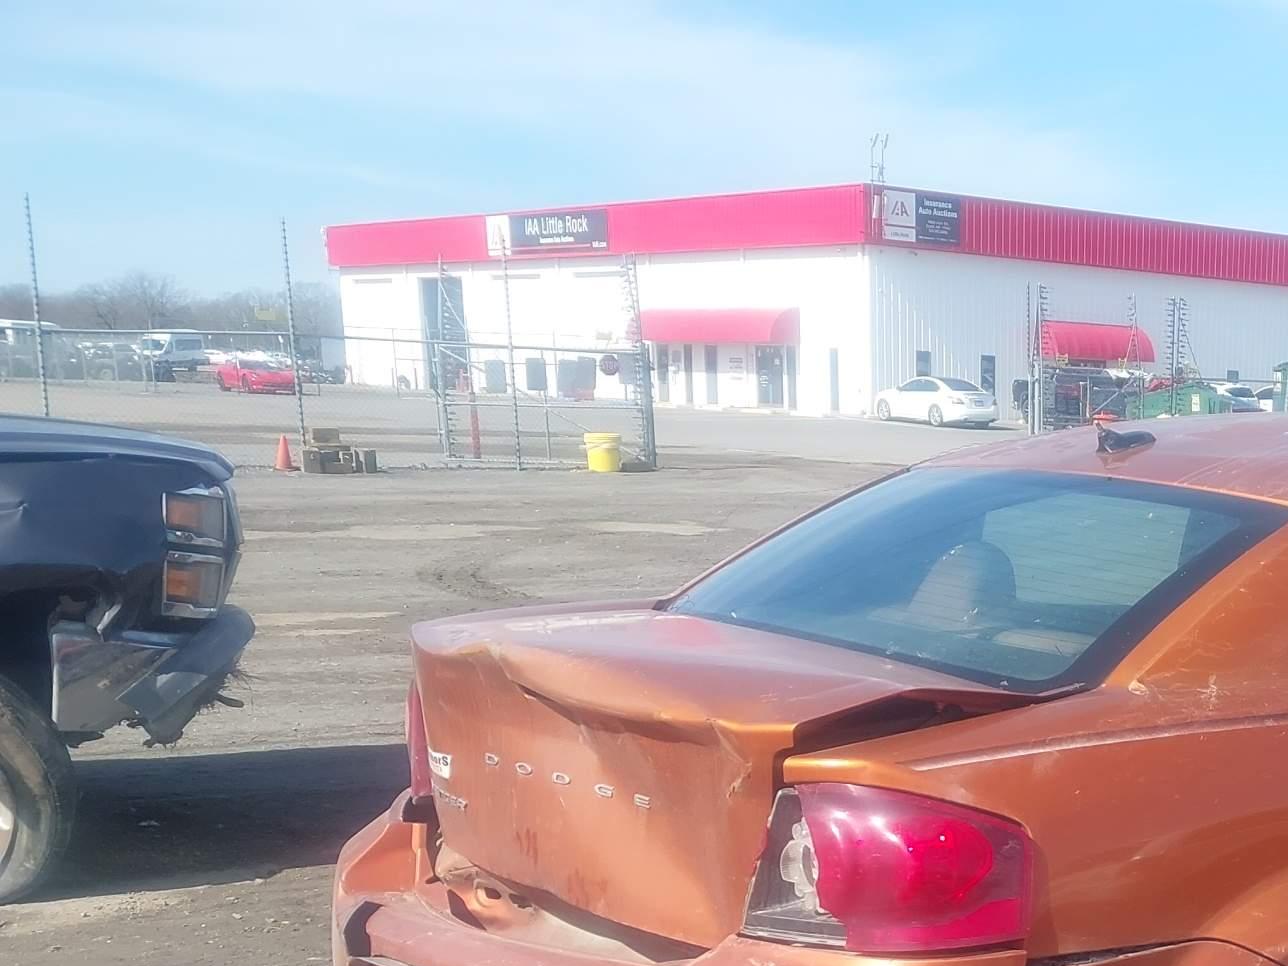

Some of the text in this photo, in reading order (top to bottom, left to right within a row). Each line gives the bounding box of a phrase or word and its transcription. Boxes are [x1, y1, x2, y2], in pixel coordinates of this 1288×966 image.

[923, 198, 952, 209] Insurance
[918, 206, 958, 218] Auto Auctions
[524, 217, 540, 235] IAA
[541, 216, 564, 234] Little
[565, 214, 588, 233] Rock
[484, 752, 652, 810] DODGE
